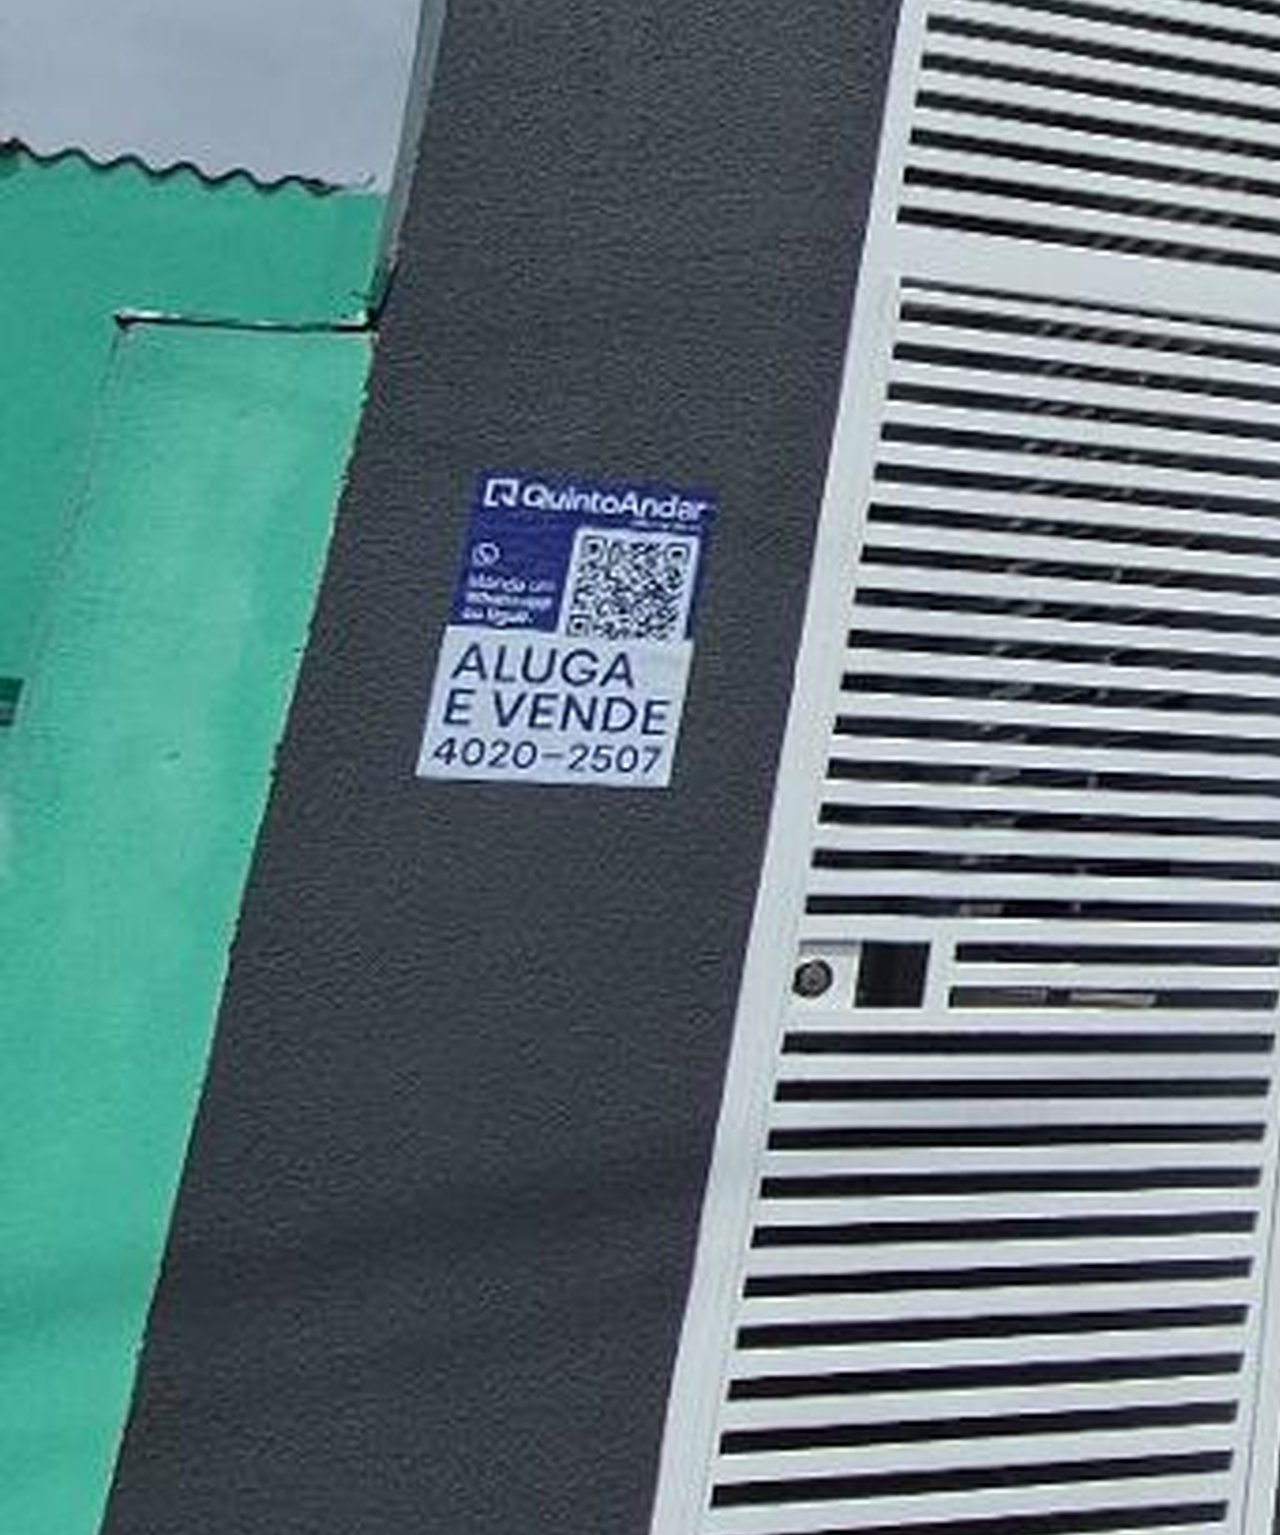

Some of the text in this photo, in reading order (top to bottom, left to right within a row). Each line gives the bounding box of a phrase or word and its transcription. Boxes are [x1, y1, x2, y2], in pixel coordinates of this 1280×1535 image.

[522, 483, 707, 522] QuintoAndar
[452, 643, 634, 688] ALUGA
[443, 689, 671, 735] E VENDE
[433, 737, 662, 774] 4020-2507
